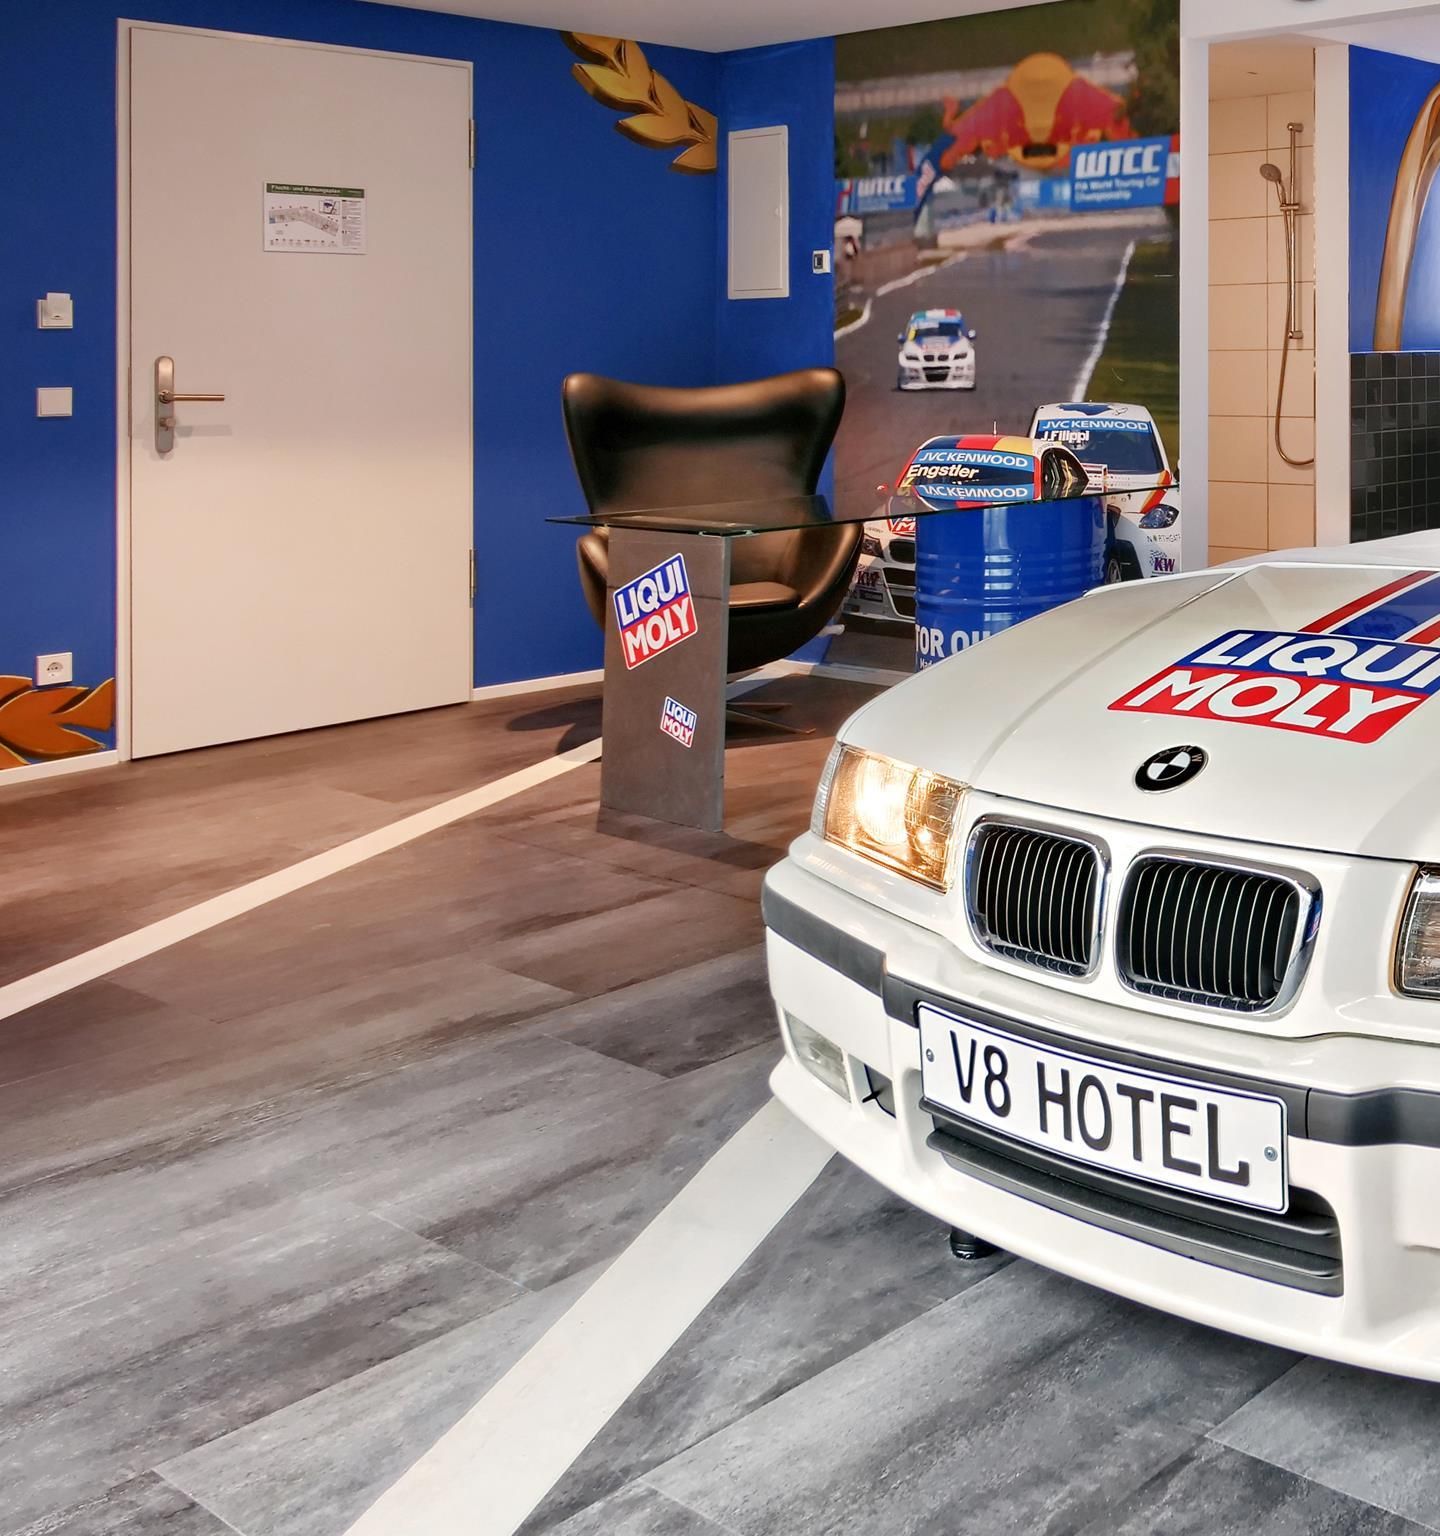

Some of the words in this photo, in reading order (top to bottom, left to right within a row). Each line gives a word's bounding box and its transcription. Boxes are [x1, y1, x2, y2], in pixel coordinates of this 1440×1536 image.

[1075, 144, 1163, 179] WTCC
[906, 464, 980, 479] Engstler
[1154, 557, 1175, 572] KW
[617, 560, 684, 626] LIQUI
[624, 597, 689, 663] MOLY
[666, 700, 695, 729] LIQUI
[1123, 669, 1423, 735] MOLY
[663, 714, 693, 744] MOLY
[949, 1030, 1012, 1118] V8
[1036, 1061, 1251, 1188] HOTEL
